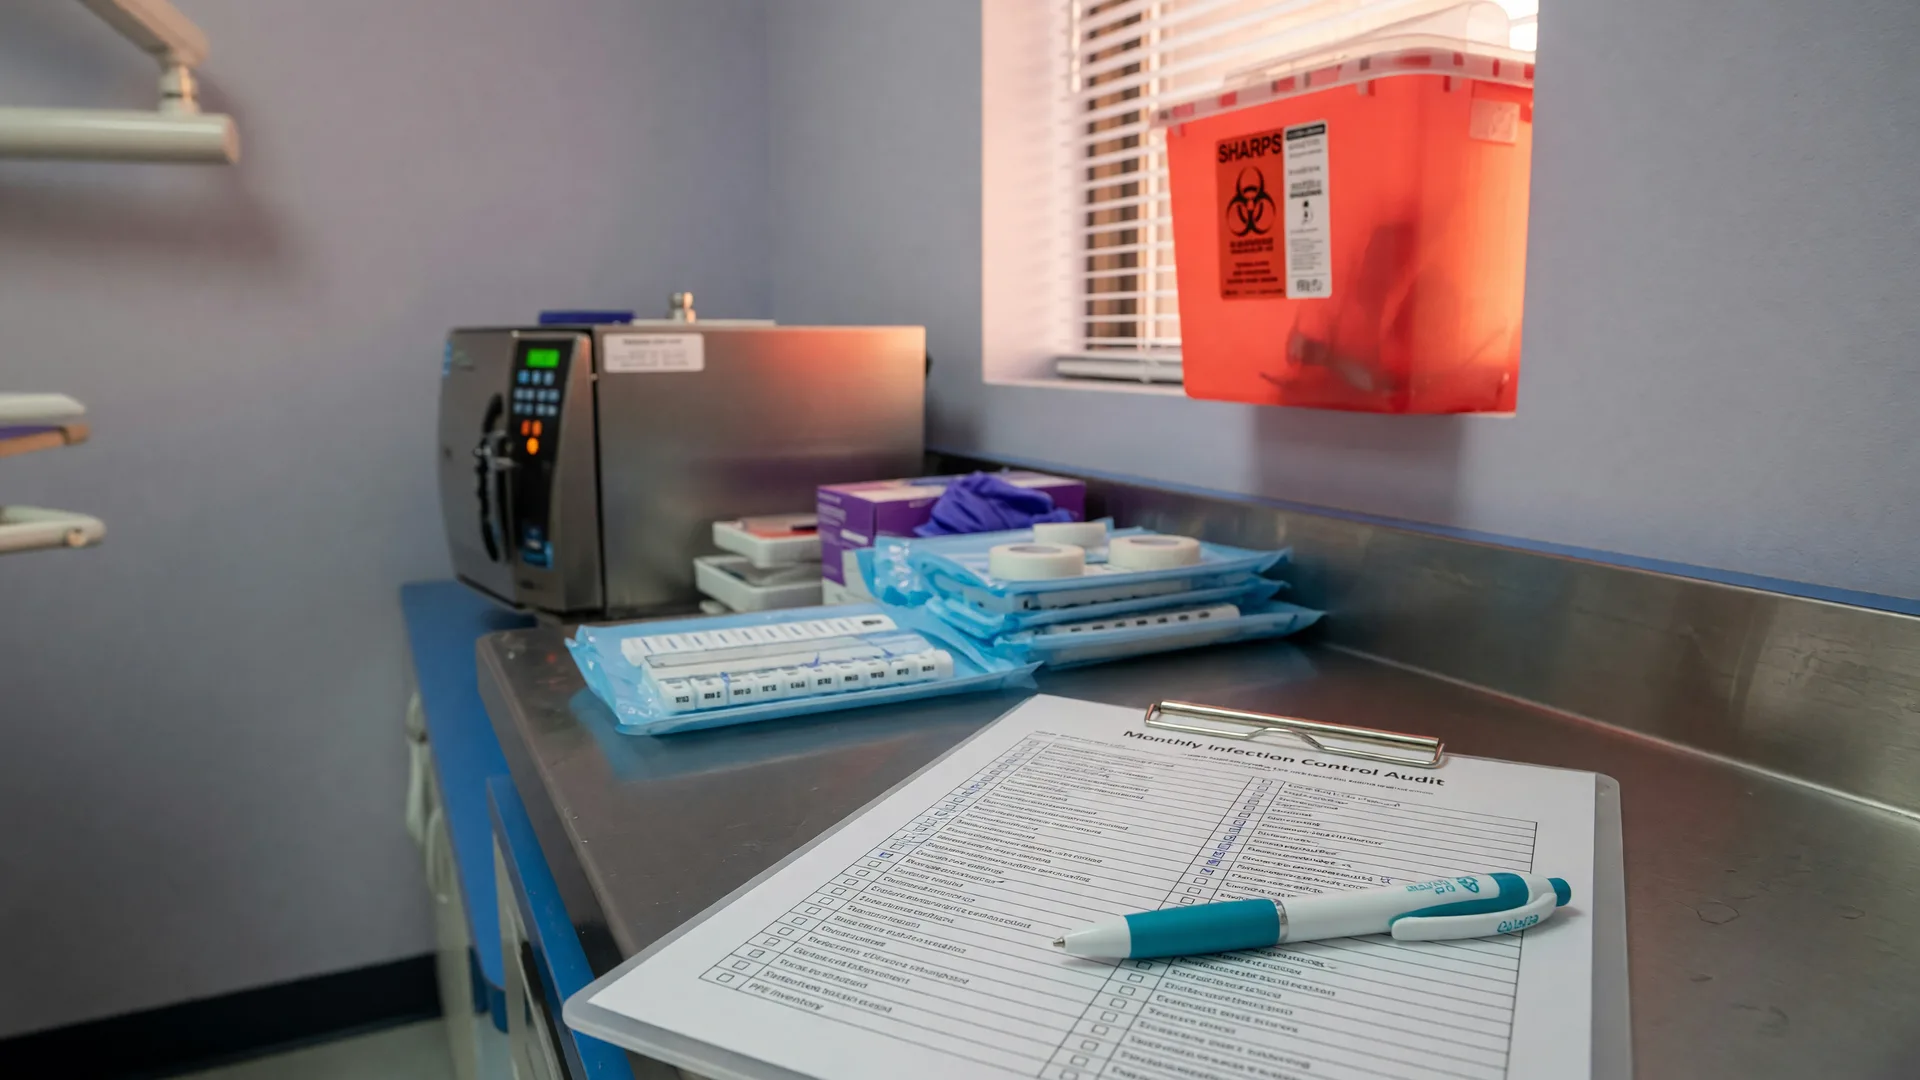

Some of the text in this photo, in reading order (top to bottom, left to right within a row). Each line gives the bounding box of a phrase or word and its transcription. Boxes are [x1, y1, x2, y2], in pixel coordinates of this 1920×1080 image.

[1218, 133, 1281, 163] SHARPS
[1123, 730, 1203, 749] Monthly
[1208, 744, 1295, 764] Infection
[1301, 758, 1379, 776] Control
[1384, 771, 1446, 787] Audit
[749, 982, 770, 994] PPE
[769, 988, 824, 1010] inventory
